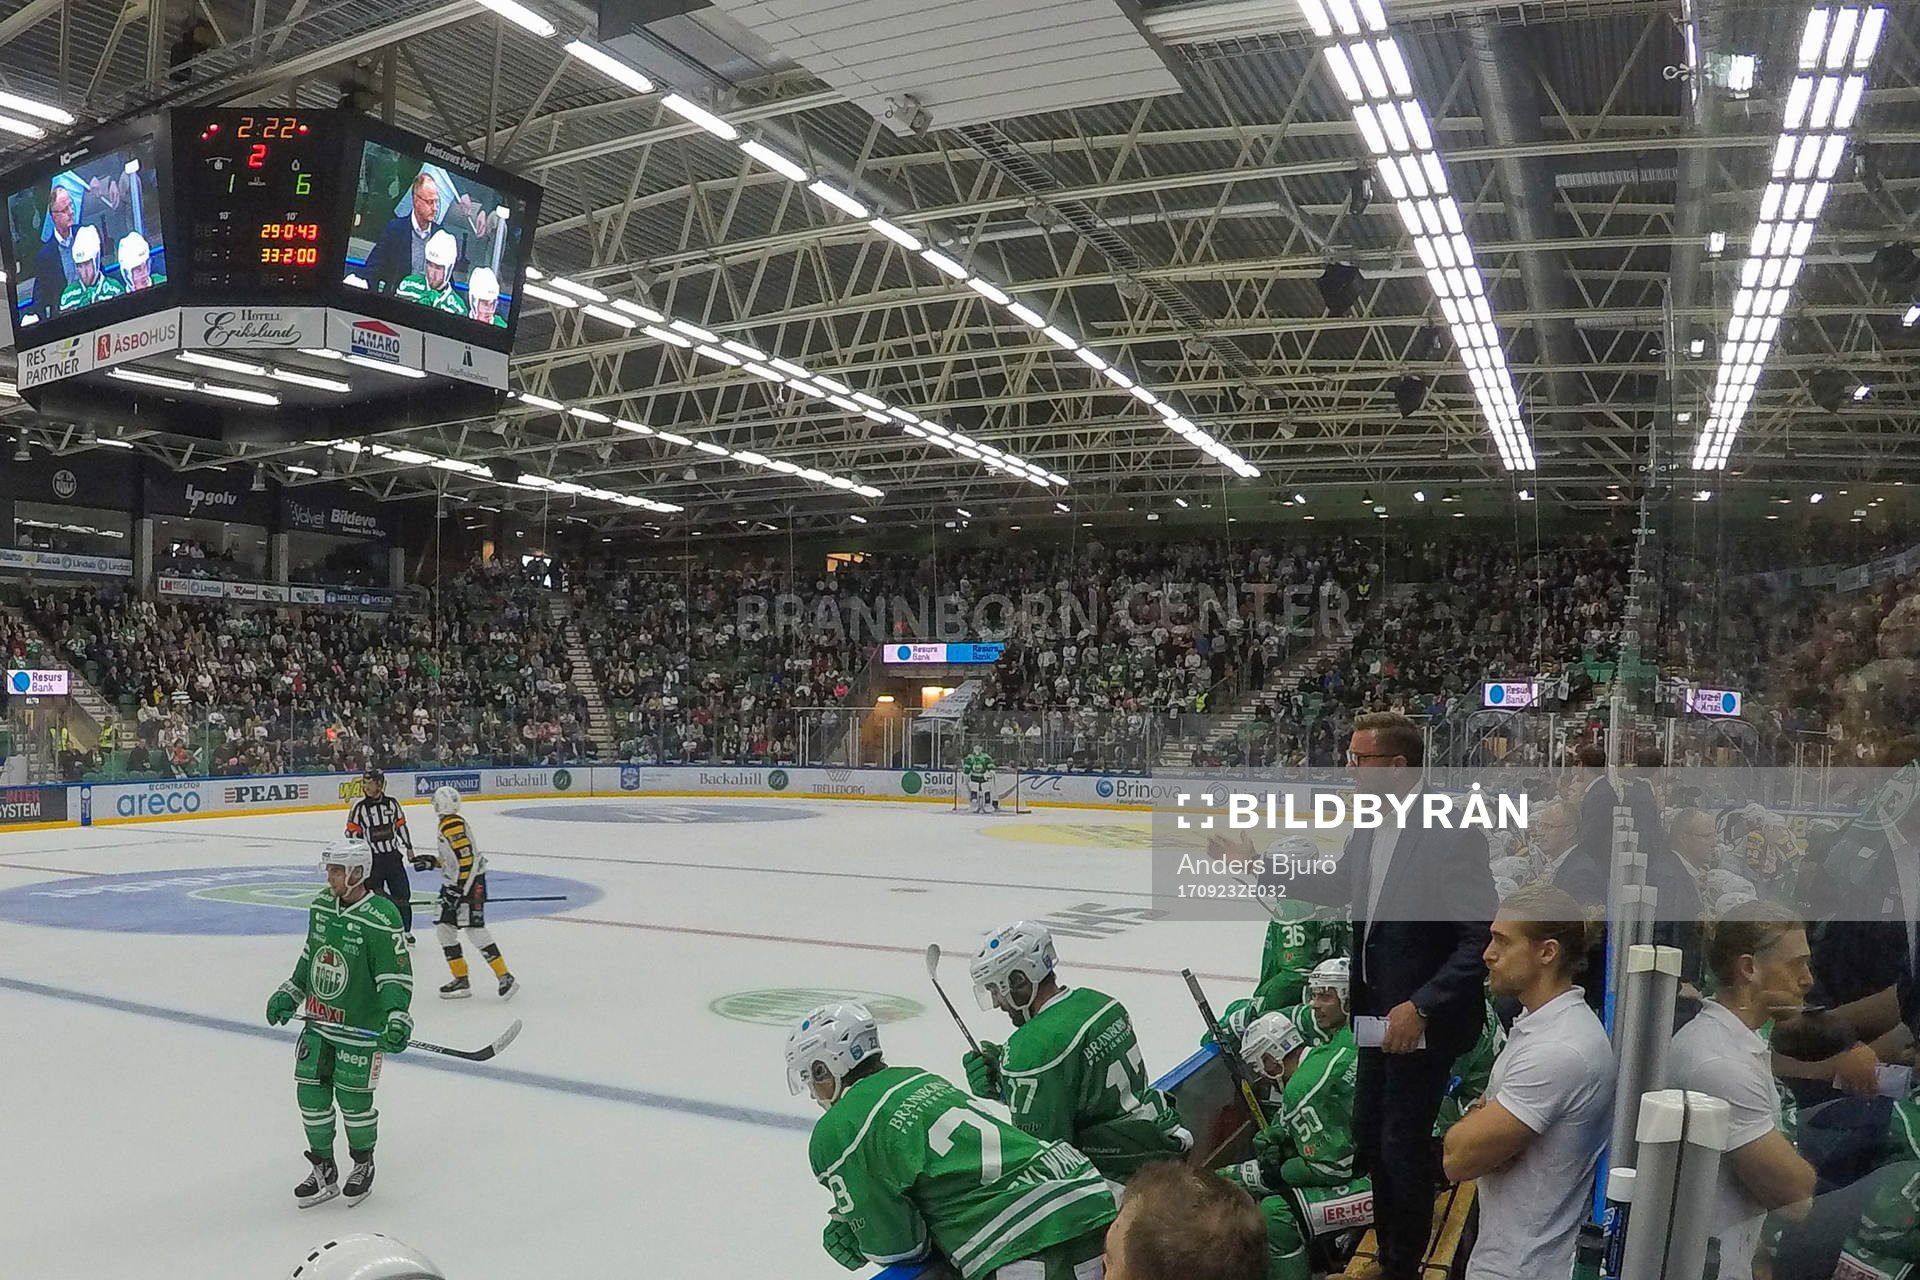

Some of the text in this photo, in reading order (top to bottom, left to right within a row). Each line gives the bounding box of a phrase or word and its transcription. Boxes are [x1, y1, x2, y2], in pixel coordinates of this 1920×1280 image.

[237, 116, 297, 138] 2:22
[248, 143, 268, 169] 2
[228, 173, 236, 193] 1
[295, 173, 312, 195] 6
[114, 323, 176, 355] ÅSBOHUS
[204, 311, 302, 347] Erikslund
[351, 328, 400, 354] LAMARO
[26, 348, 46, 368] RES
[26, 358, 80, 385] PARTNER
[735, 580, 1351, 642] BRÄNNBORN CENTER
[32, 671, 62, 682] Resurs
[32, 682, 54, 692] Bank
[495, 773, 548, 787] Backahill
[700, 772, 761, 785] Backahill
[812, 783, 865, 794] TRELLEBORG
[924, 772, 953, 785] Solid
[1116, 779, 1182, 799] Brinova
[117, 791, 201, 817] areco
[235, 784, 299, 803] PEAB
[306, 993, 345, 1024] MAXI
[336, 1050, 368, 1067] Jeep
[1007, 1078, 1039, 1114] 17
